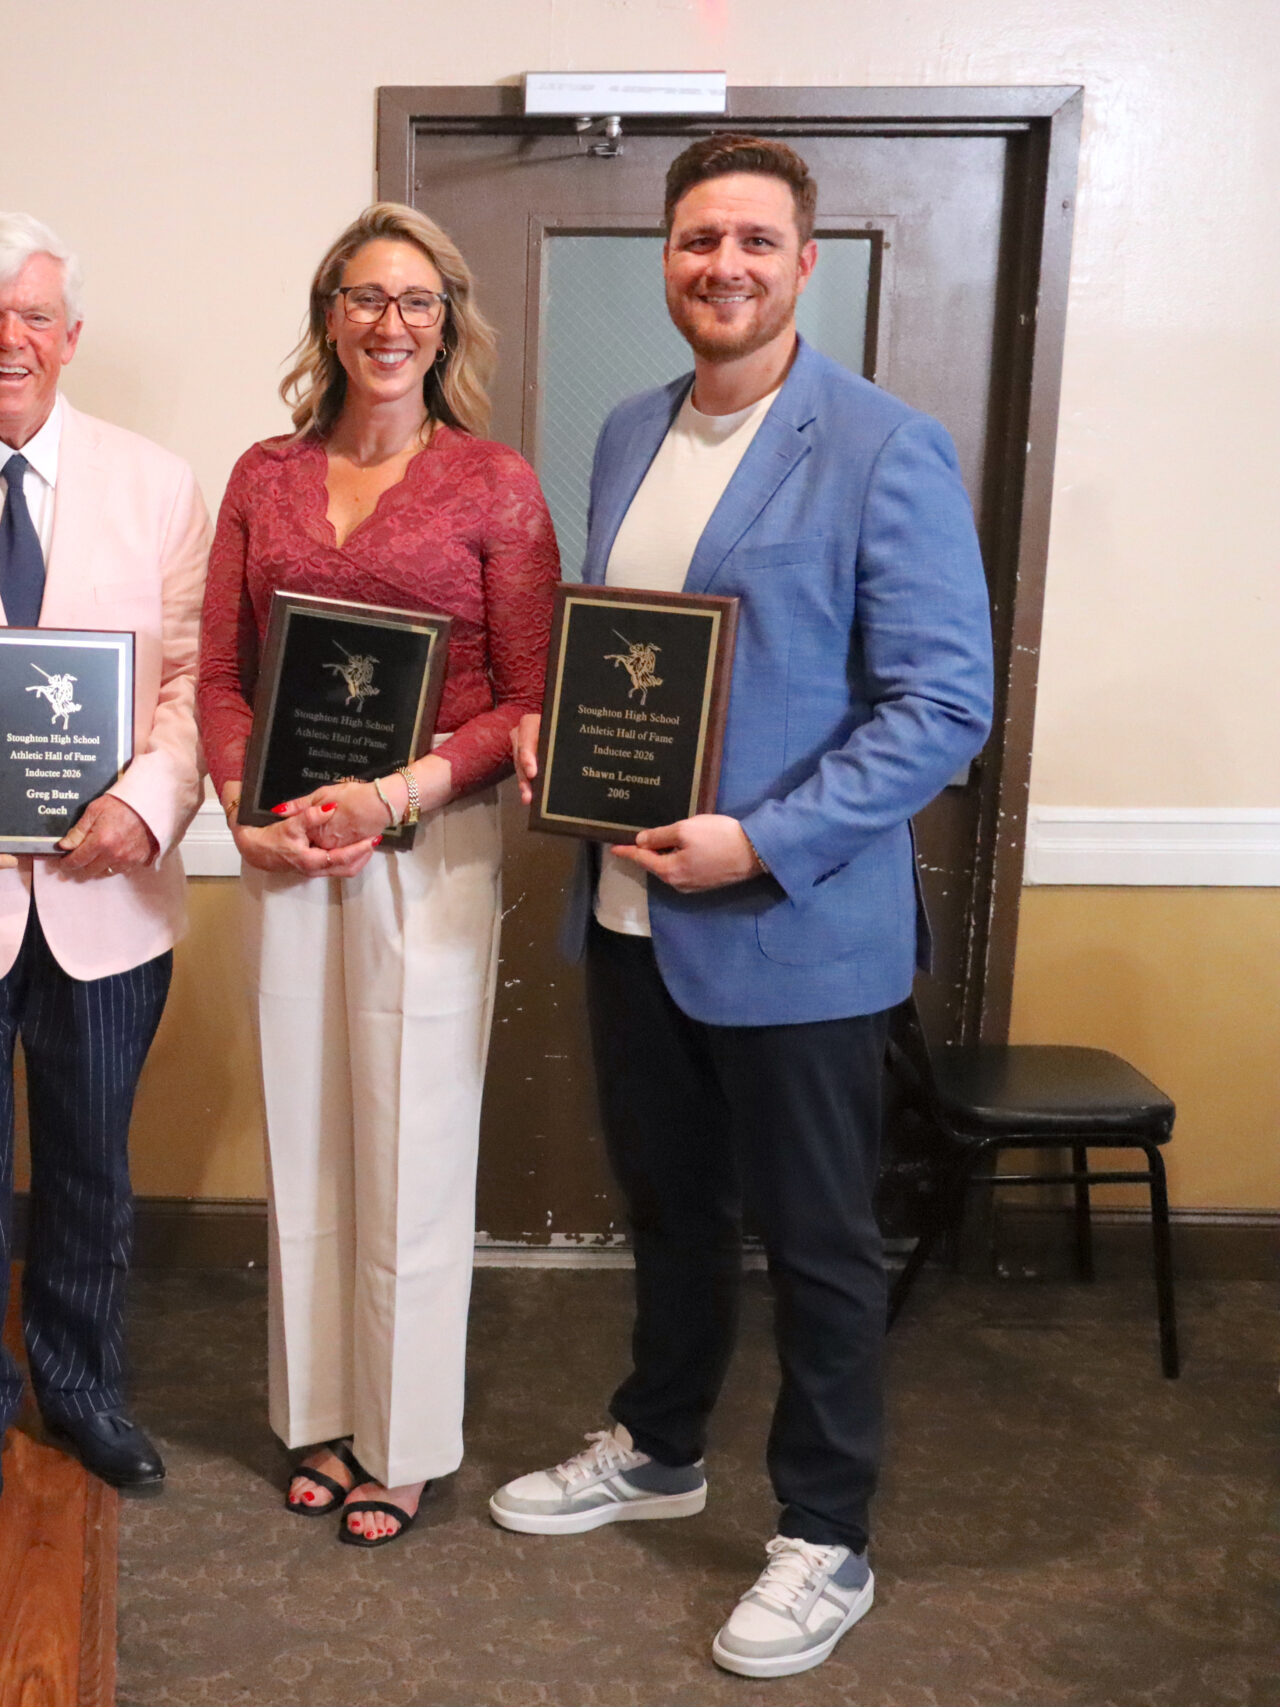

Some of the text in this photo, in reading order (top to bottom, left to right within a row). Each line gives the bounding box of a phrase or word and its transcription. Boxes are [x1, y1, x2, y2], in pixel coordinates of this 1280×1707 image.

[294, 709, 394, 732] Stoughton High School
[578, 704, 680, 725] Stoughton High School
[6, 733, 100, 745] Stoughton High School
[296, 728, 388, 749] Athletic Hall of Fame
[580, 724, 674, 744] Athletic Hall of Fame
[10, 750, 96, 762] Athletic Hall of Fame
[308, 747, 368, 764] Inductee 2026
[594, 744, 654, 760] Inductee 2026
[25, 768, 81, 778] Inductee 2026
[302, 768, 330, 780] Sarah
[582, 766, 660, 786] Shawn Leonard
[26, 789, 79, 800] Greg Burke
[608, 788, 630, 800] 2005
[38, 805, 67, 815] Coach
